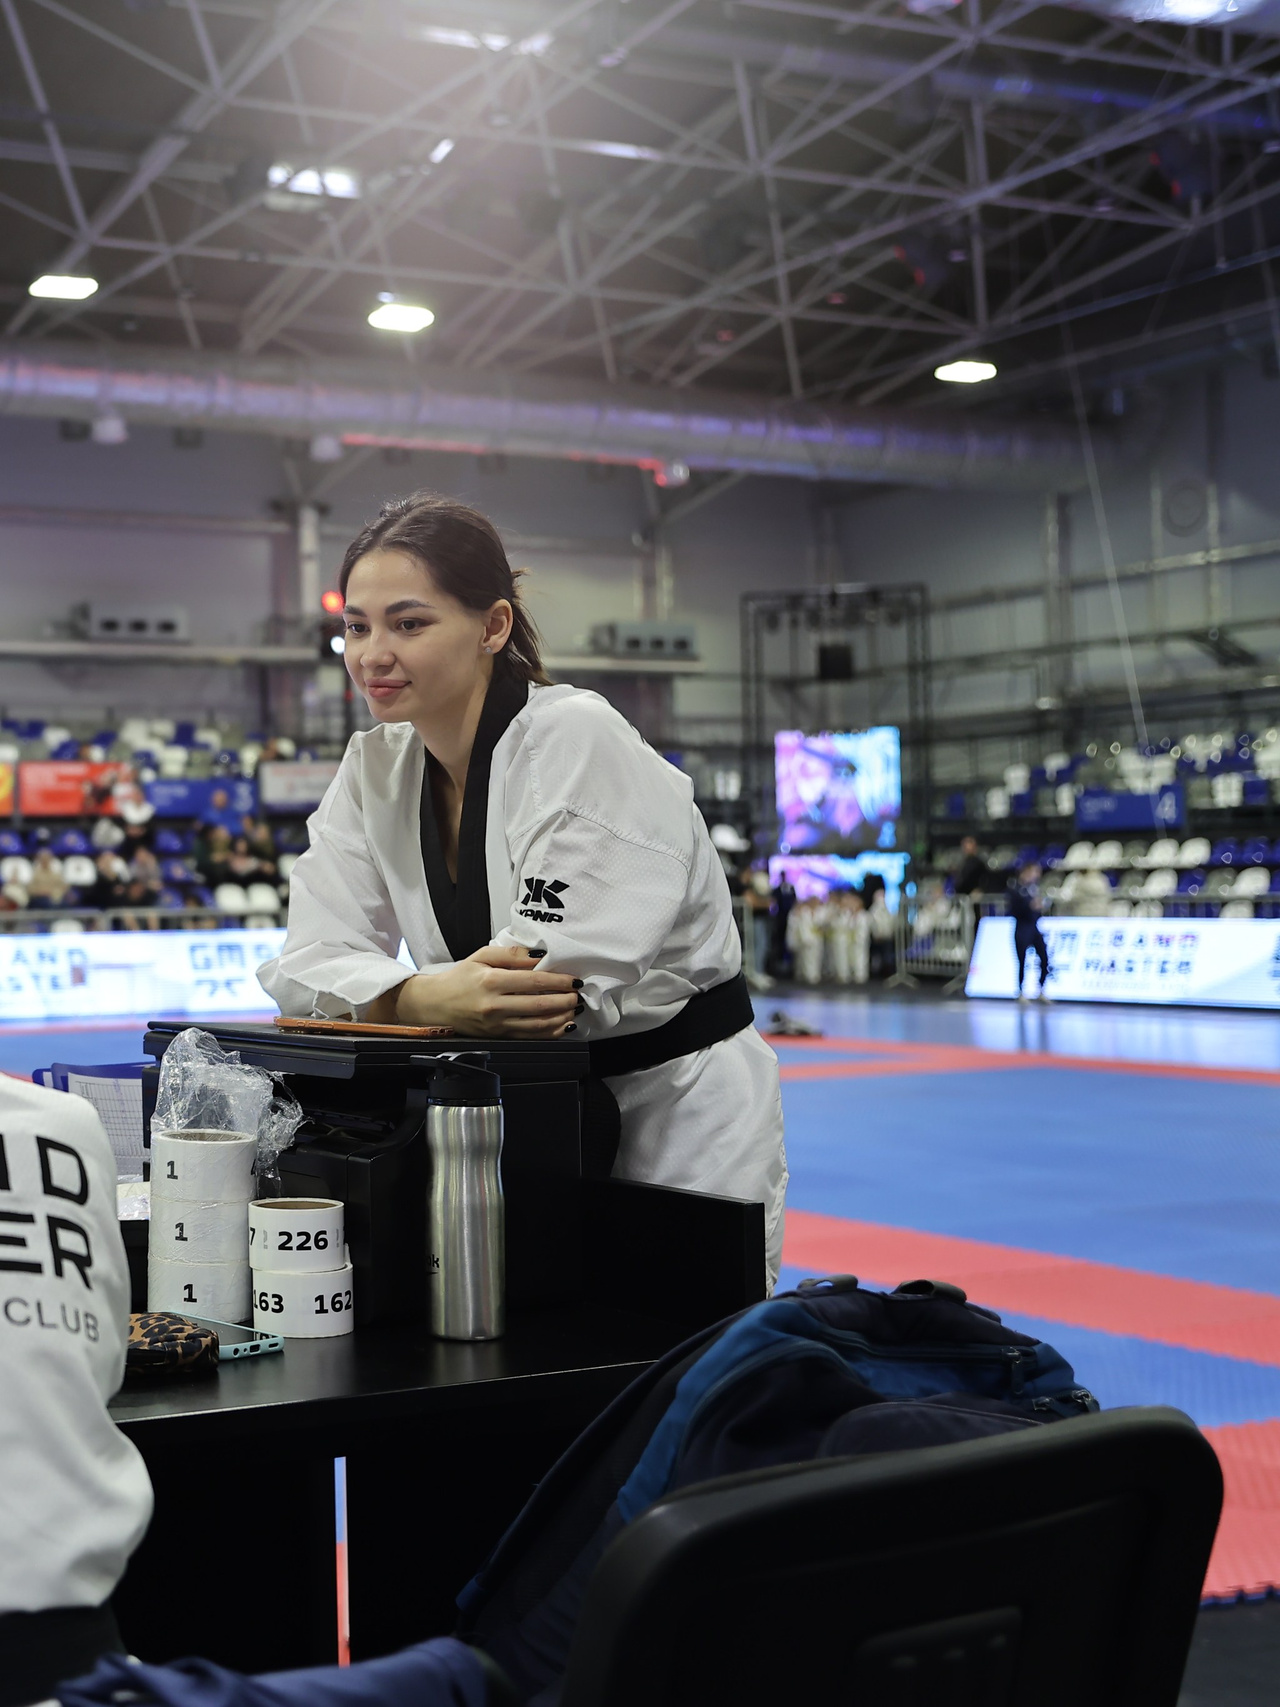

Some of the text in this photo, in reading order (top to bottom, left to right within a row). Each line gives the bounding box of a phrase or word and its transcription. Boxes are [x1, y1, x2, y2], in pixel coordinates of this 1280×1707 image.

[166, 1160, 179, 1180] 1
[175, 1222, 188, 1242] 1
[277, 1229, 329, 1251] 226
[183, 1283, 197, 1303] 1
[314, 1290, 352, 1315] 162
[3, 1297, 100, 1343] CLUB
